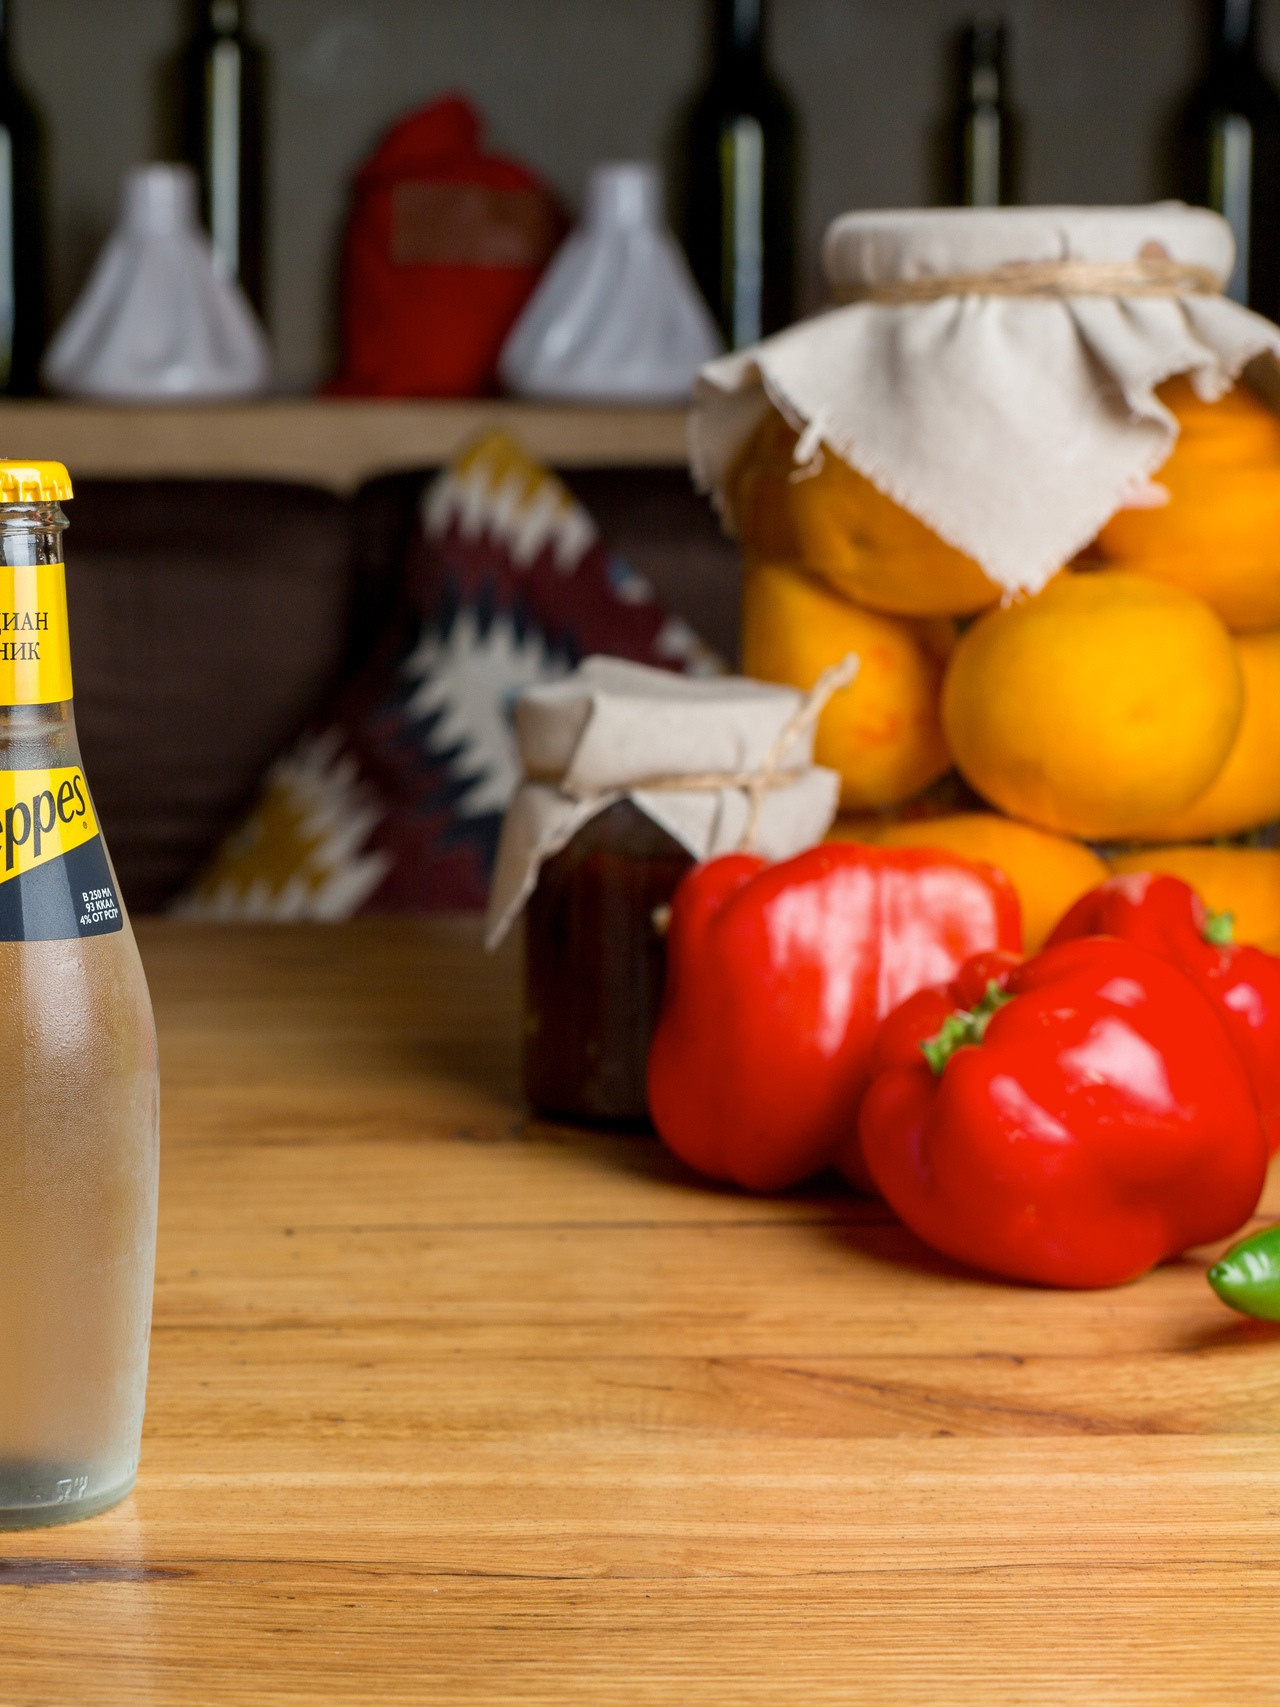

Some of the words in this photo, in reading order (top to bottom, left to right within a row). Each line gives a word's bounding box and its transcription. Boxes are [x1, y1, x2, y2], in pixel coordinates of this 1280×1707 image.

[82, 892, 89, 902] В
[89, 889, 102, 901] 250
[85, 902, 95, 913] 93
[95, 898, 115, 911] ККАЛ
[80, 914, 92, 925] 4%
[92, 911, 103, 923] ОТ
